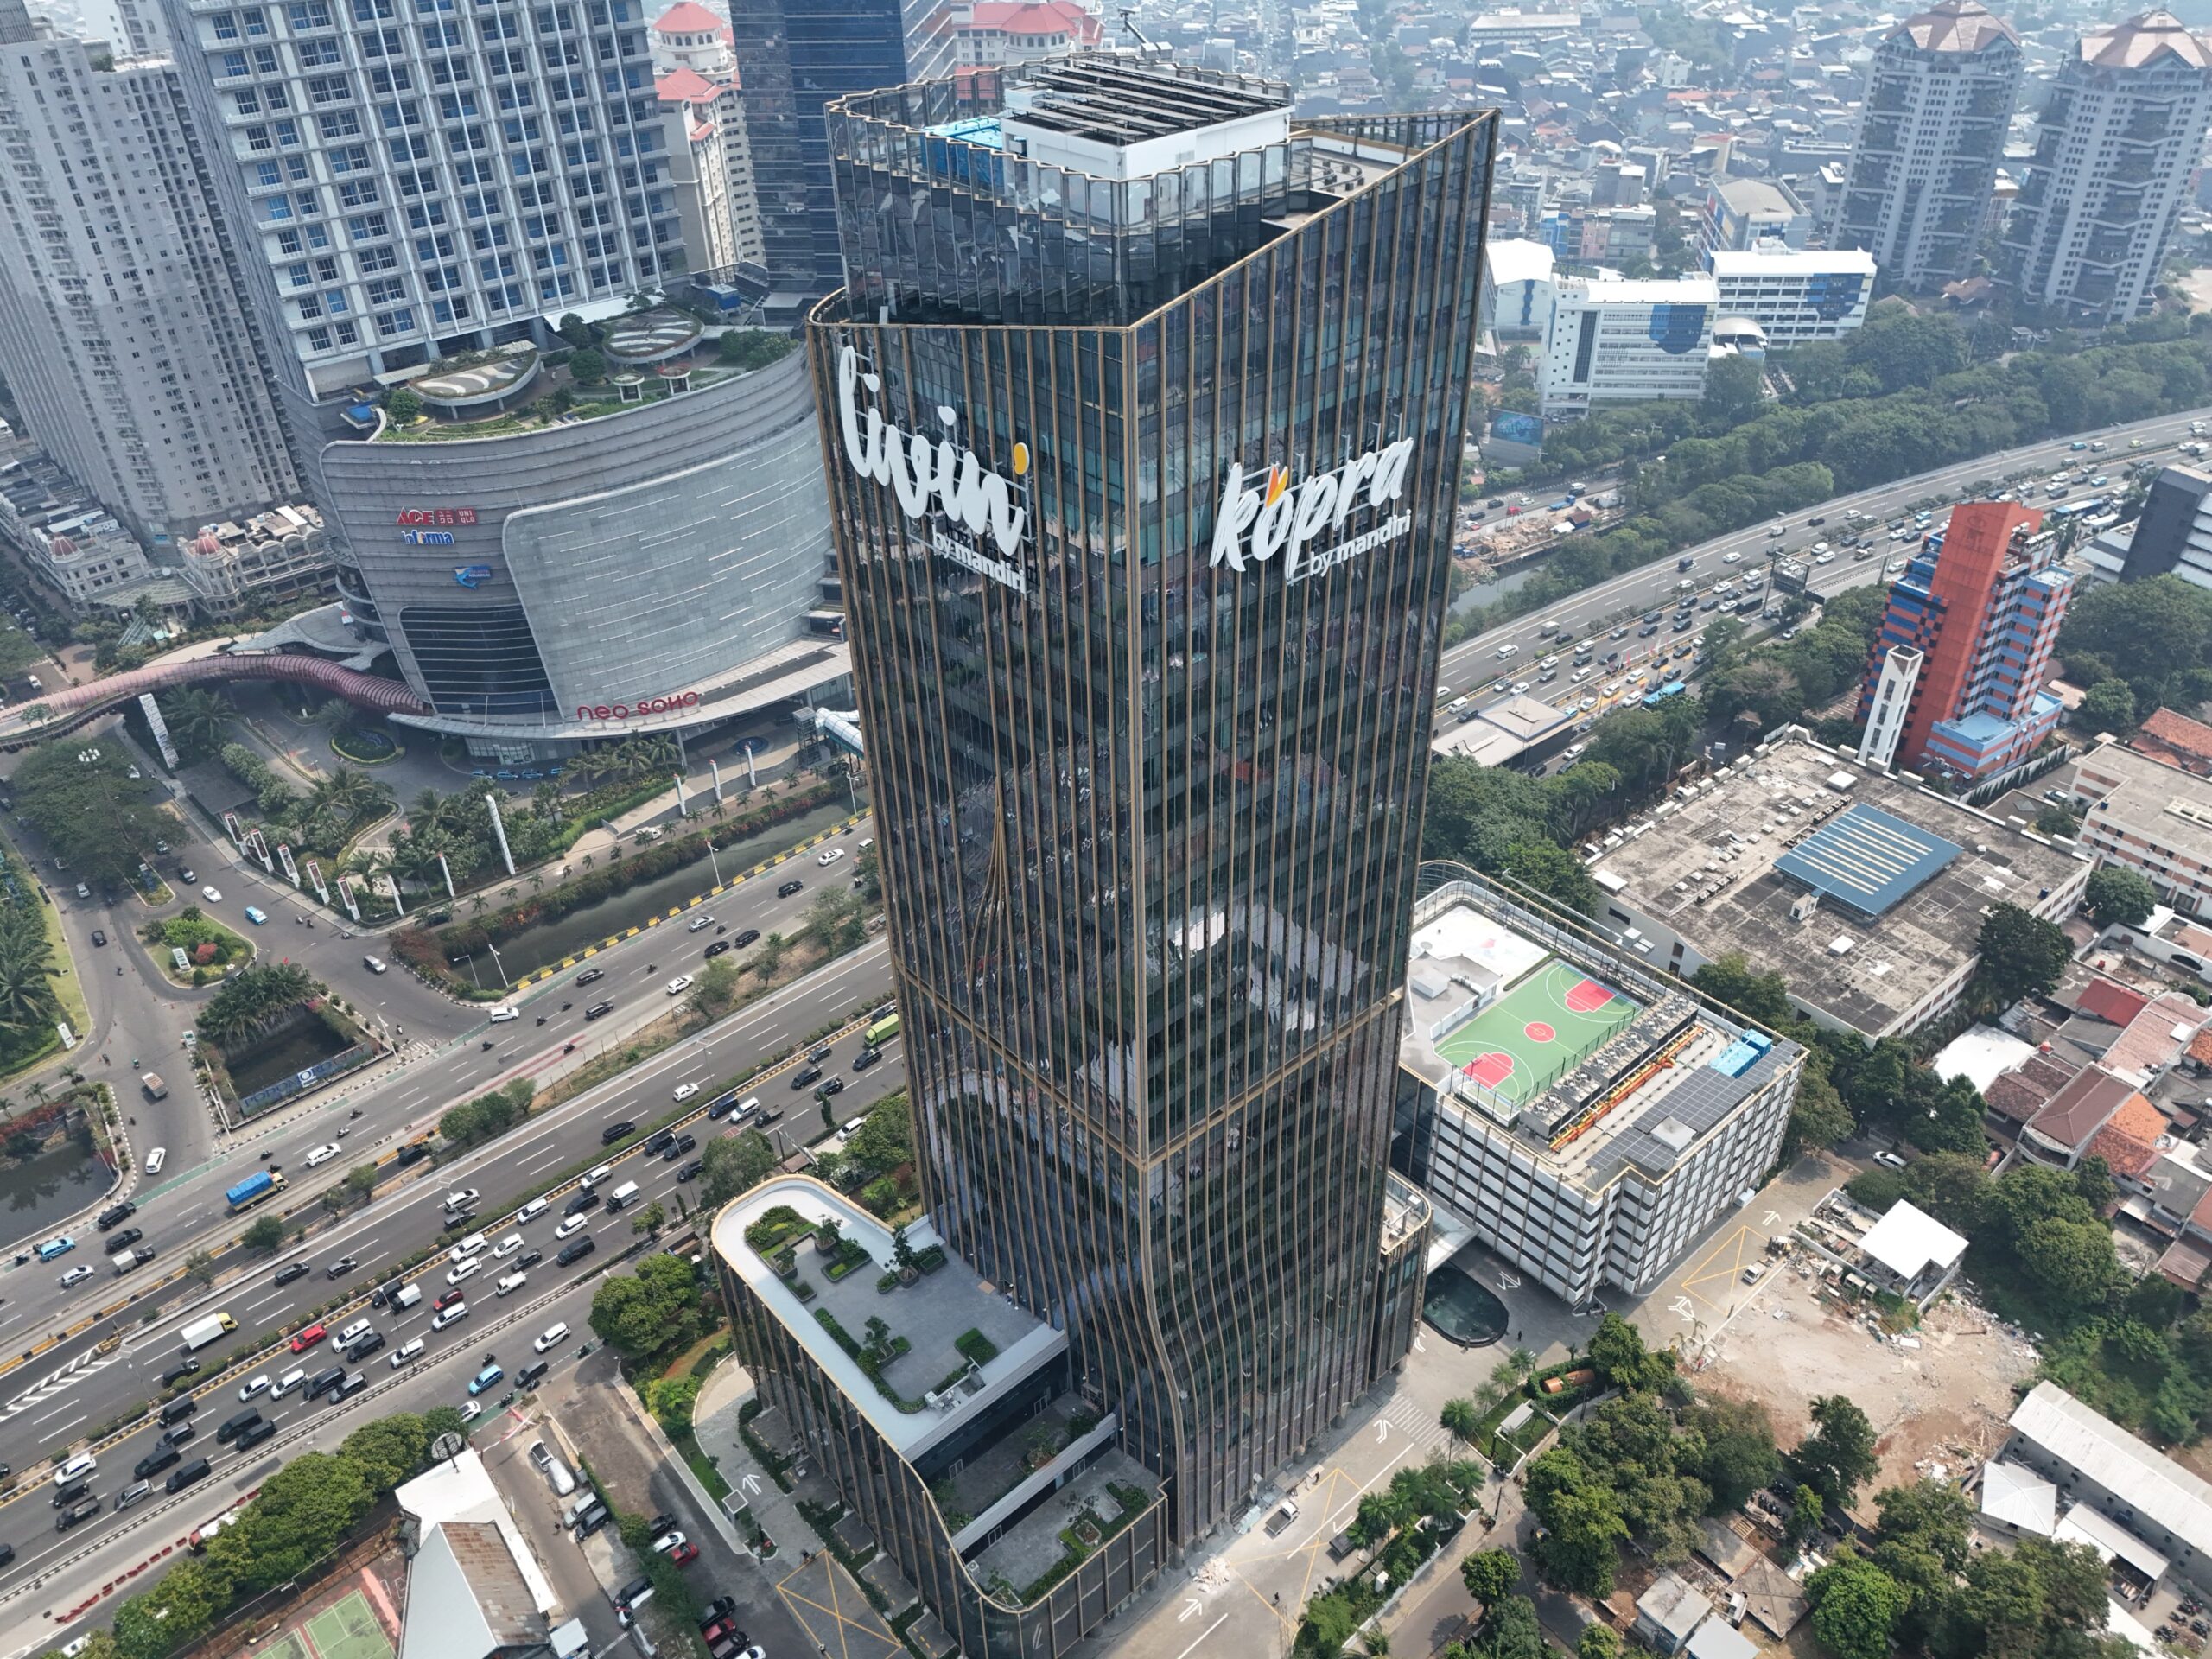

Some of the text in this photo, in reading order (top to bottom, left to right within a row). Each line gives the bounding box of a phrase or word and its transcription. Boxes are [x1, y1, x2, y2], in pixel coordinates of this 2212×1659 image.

[397, 506, 434, 525] ACE
[1209, 437, 1414, 582] kopra
[401, 529, 454, 544] informa
[1308, 509, 1412, 577] by mandiri
[932, 524, 1027, 594] by mandiri
[576, 704, 629, 720] neo
